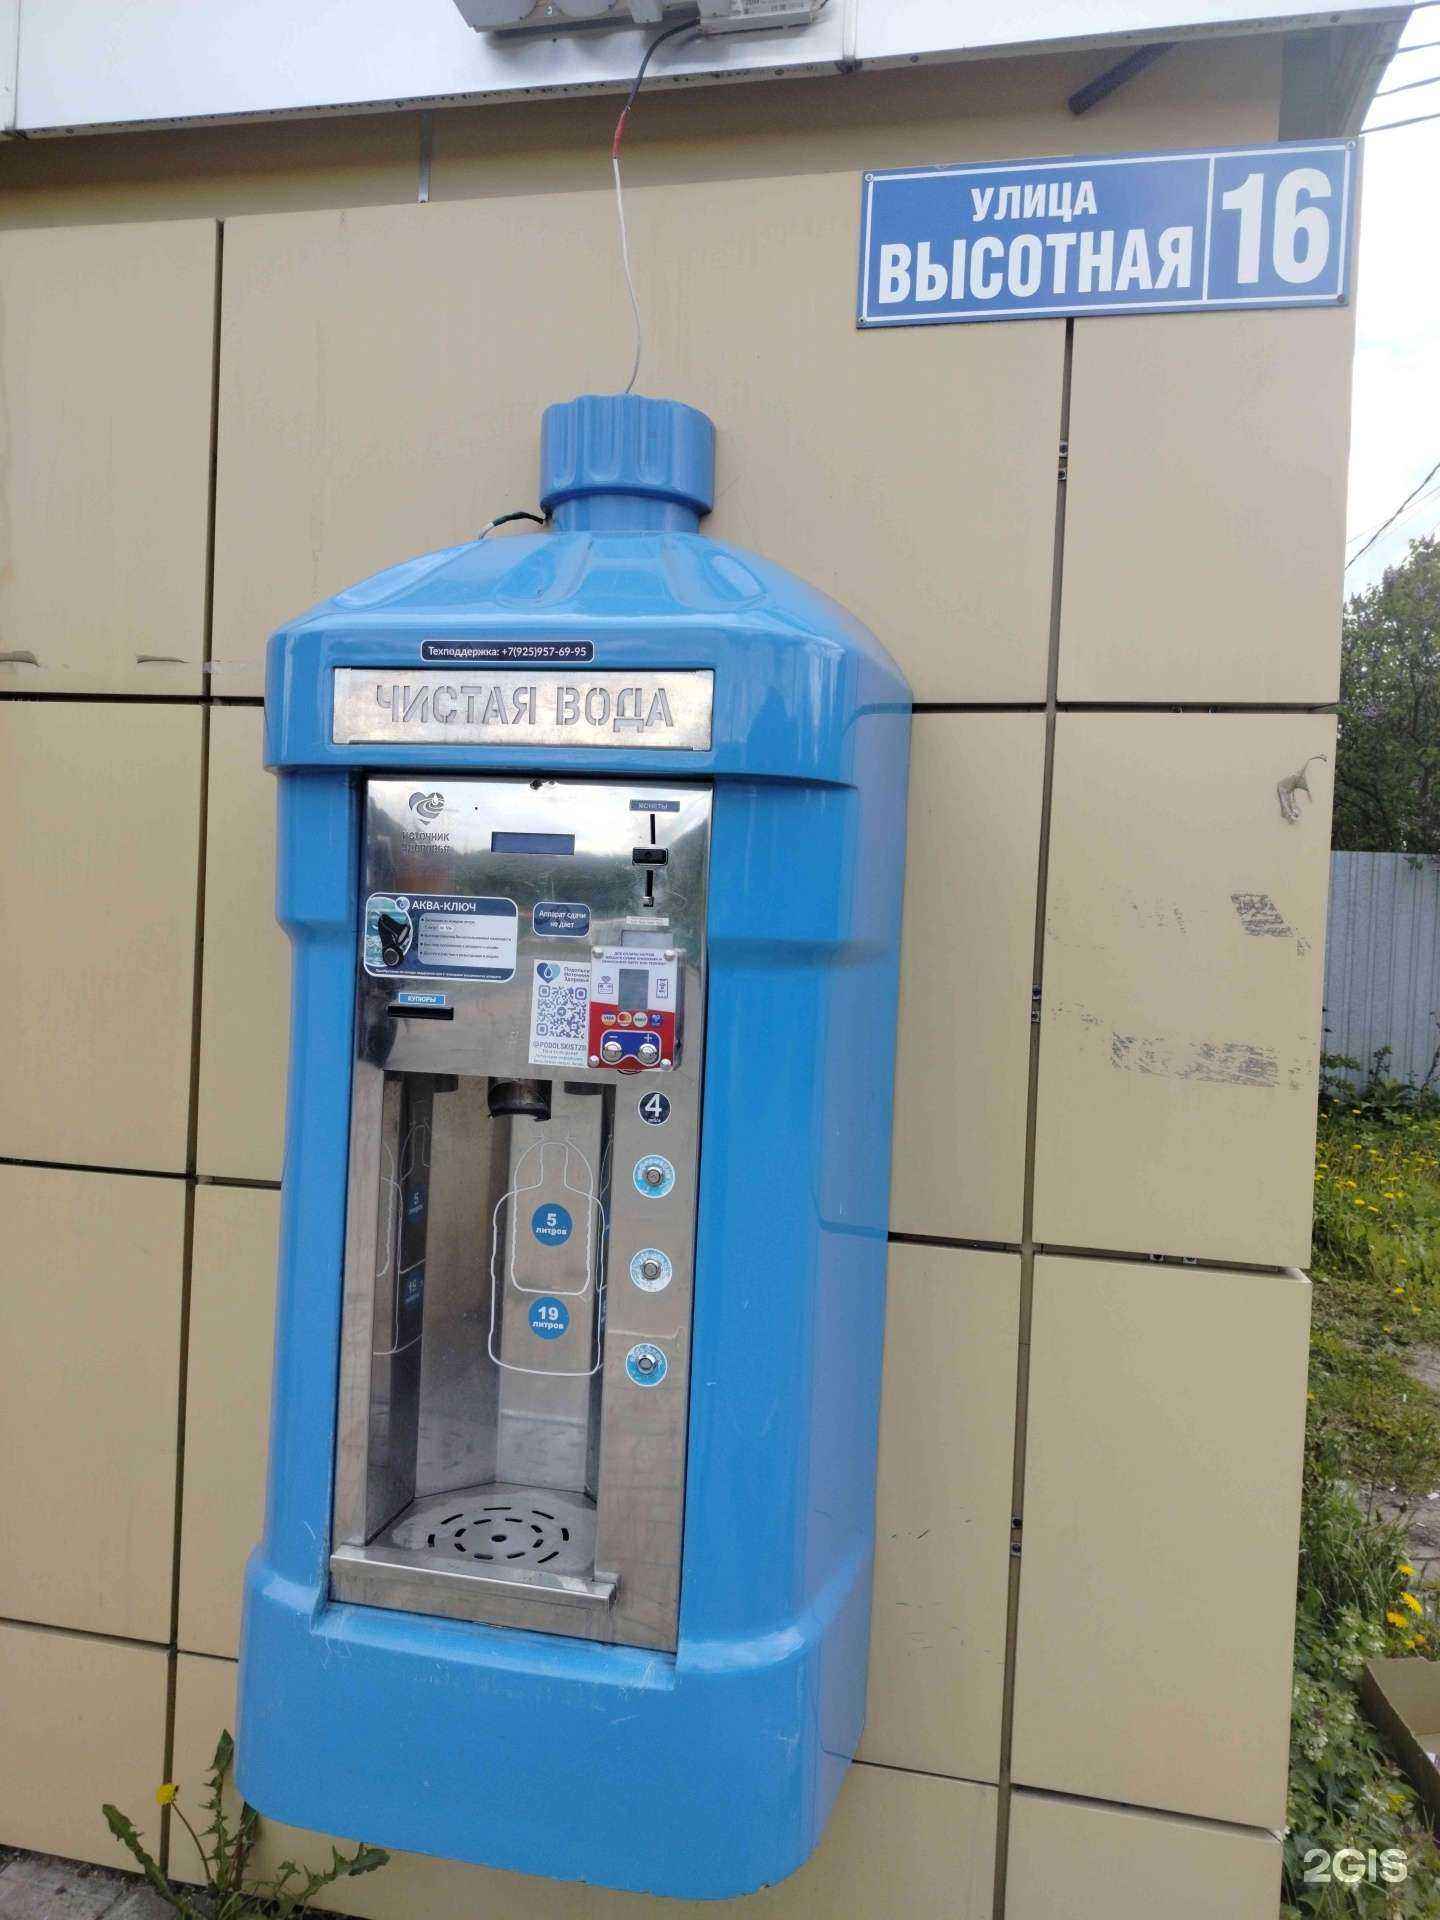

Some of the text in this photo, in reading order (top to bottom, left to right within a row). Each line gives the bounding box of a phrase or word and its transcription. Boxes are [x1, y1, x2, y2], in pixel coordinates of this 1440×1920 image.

[971, 180, 1098, 223] УЛИЦА
[1222, 167, 1333, 285] 16
[878, 225, 1194, 304] ВЫСОТНАЯ
[428, 646, 587, 658] Техподдержка: +7(925)957-69-95
[376, 684, 674, 733] ЧИСТАЯ ВОДА
[411, 900, 477, 912] АКВА-КЛЮЧ
[645, 1093, 662, 1117] 4
[546, 1213, 557, 1227] 5
[536, 1227, 567, 1236] литров
[538, 1306, 559, 1320] 19
[532, 1321, 564, 1331] литров
